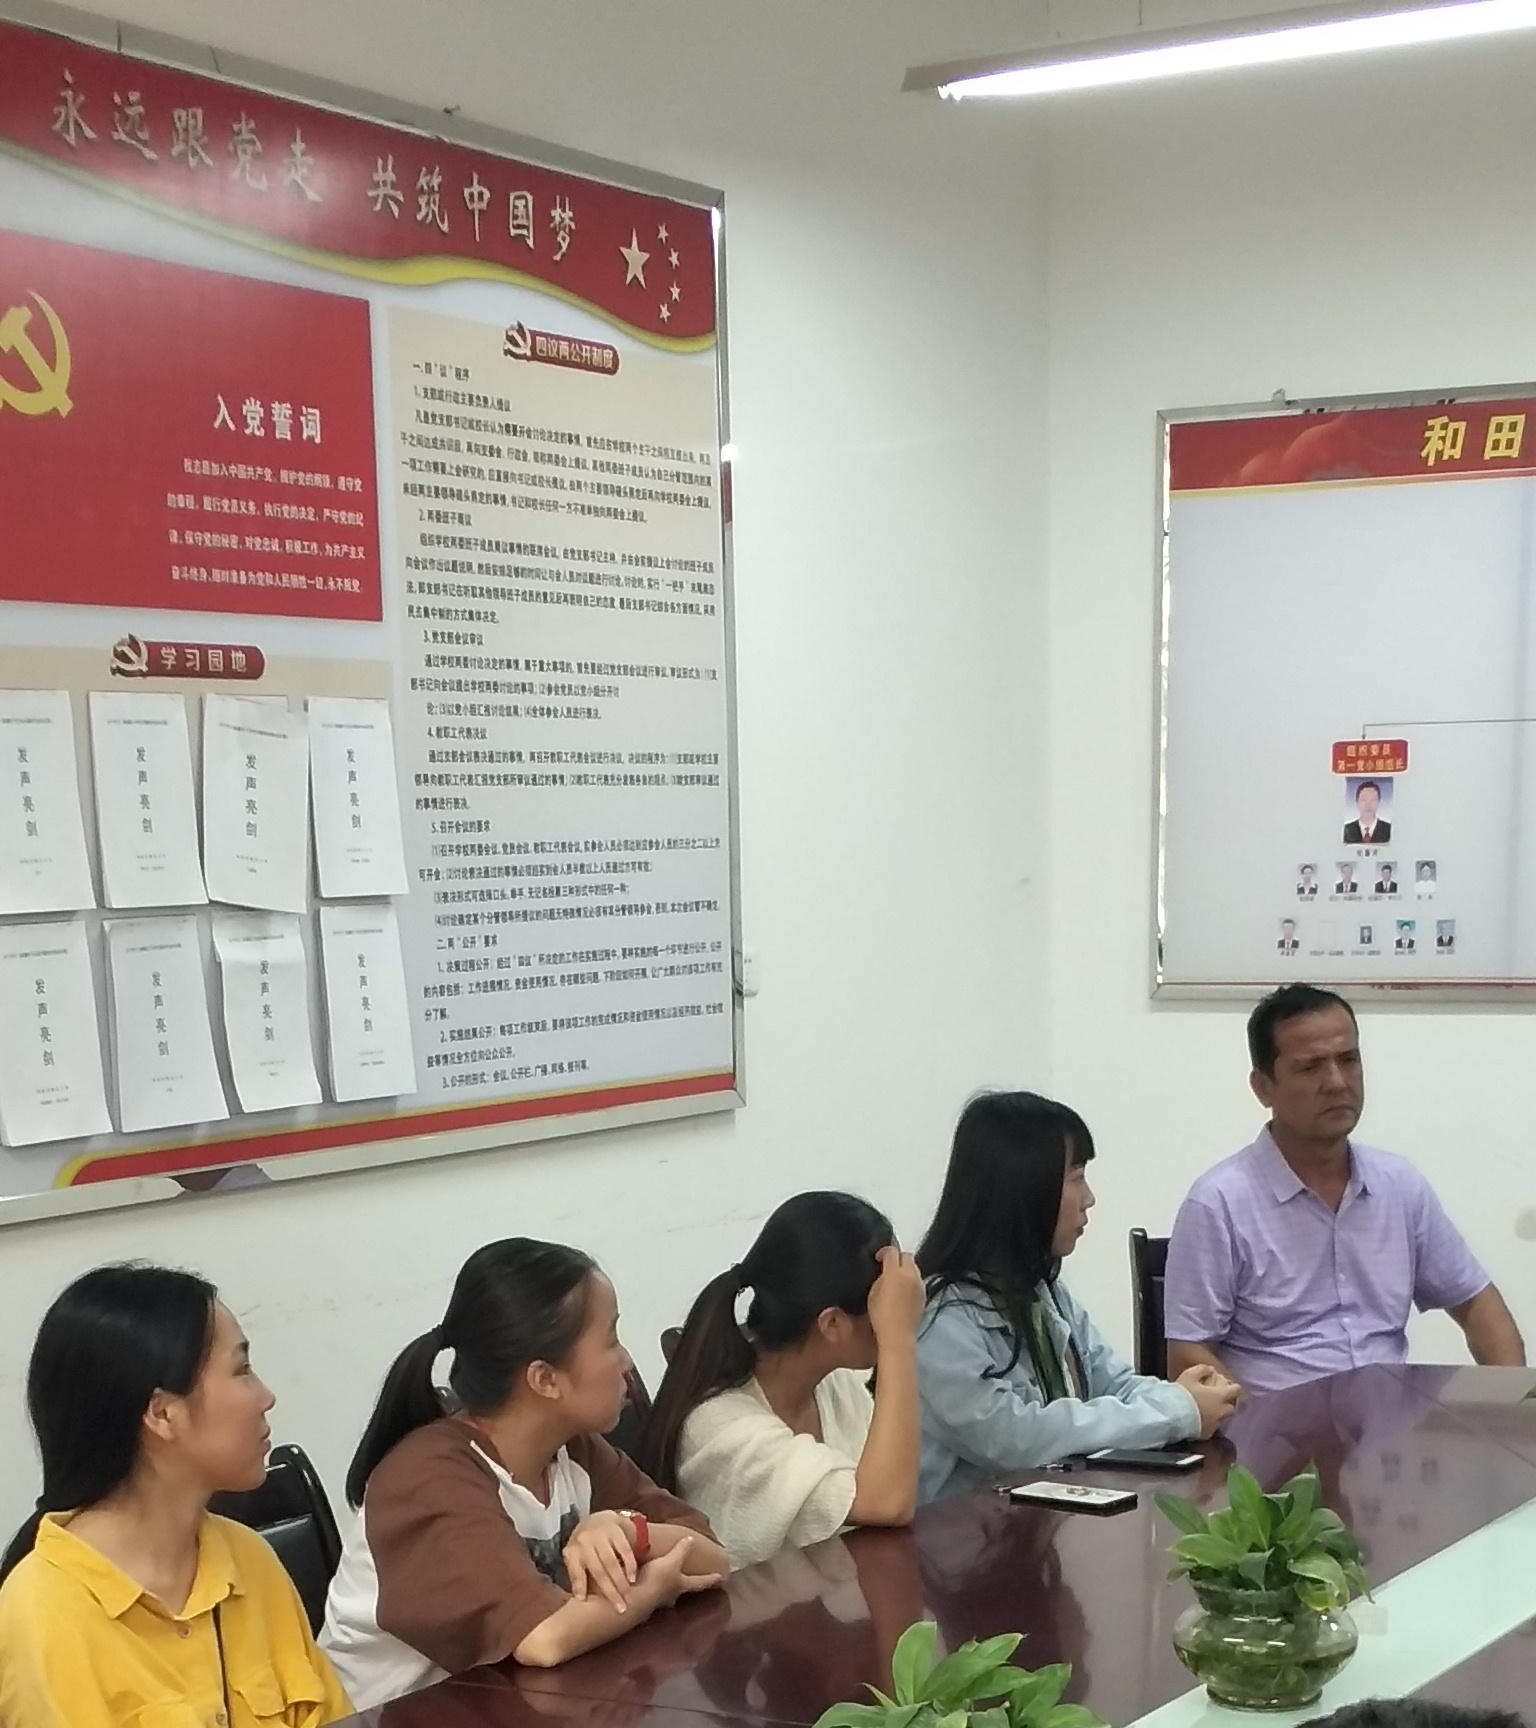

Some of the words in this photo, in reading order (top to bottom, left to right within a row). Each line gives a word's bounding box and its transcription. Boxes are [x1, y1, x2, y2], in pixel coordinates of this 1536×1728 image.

[52, 67, 322, 202] 永远跟党走
[367, 153, 576, 262] 共筑中国梦
[535, 335, 614, 369] 四议两公开制度
[213, 394, 322, 444] 入党誓词
[160, 646, 247, 673] 学习园地
[17, 746, 38, 837] 发声亮剑
[136, 746, 153, 833] 发声亮剑
[245, 754, 258, 838] 发声亮剑
[346, 748, 361, 829] 发声亮剑
[35, 978, 55, 1066] 发声亮剑
[152, 971, 169, 1056] 发声亮剑
[260, 959, 275, 1041] 发声亮剑
[357, 954, 373, 1032] 发声亮剑
